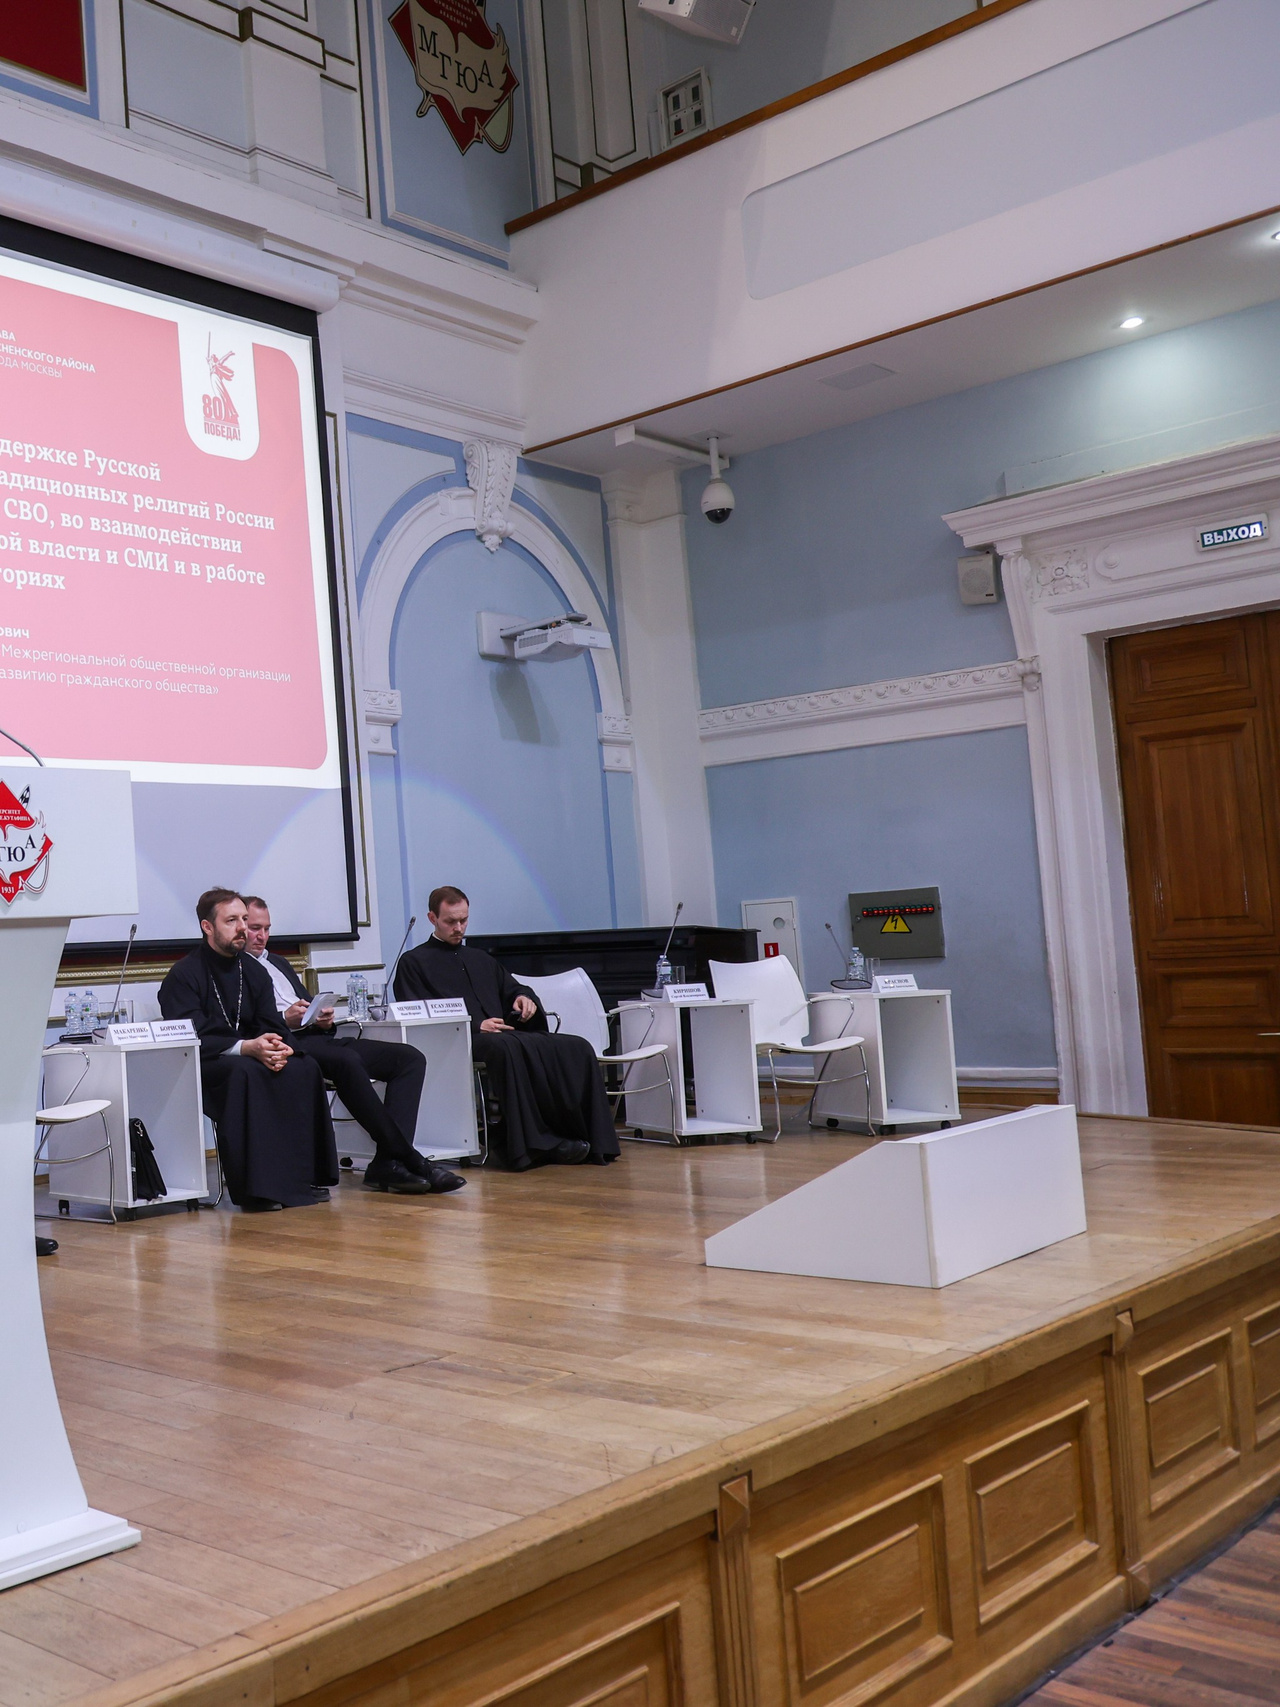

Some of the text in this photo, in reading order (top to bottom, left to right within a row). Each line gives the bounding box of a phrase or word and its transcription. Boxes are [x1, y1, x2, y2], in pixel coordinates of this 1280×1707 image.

[418, 23, 495, 94] МГЮА
[21, 362, 62, 378] МОСКВЫ
[55, 355, 96, 373] РАЙОНА
[202, 394, 223, 420] 80
[204, 422, 241, 441] ПОБЕДА!
[83, 449, 161, 482] Русской
[133, 494, 210, 520] религий
[215, 503, 275, 530] России
[3, 498, 55, 529] СВО,
[61, 510, 83, 529] во
[90, 516, 242, 554] взаимодействии
[1203, 523, 1262, 545] ВЫХОД
[28, 538, 100, 562] власти
[106, 549, 119, 564] и
[124, 548, 169, 572] СМИ
[174, 559, 186, 574] и
[191, 560, 201, 576] в
[206, 563, 266, 585] работе
[1, 645, 127, 668] Межрегиональной
[129, 656, 216, 676] общественной
[219, 666, 291, 683] организации
[60, 672, 153, 690] гражданского
[155, 679, 219, 695] общества»
[1, 886, 15, 894] 1931
[159, 1024, 187, 1032] БОРИСОВ
